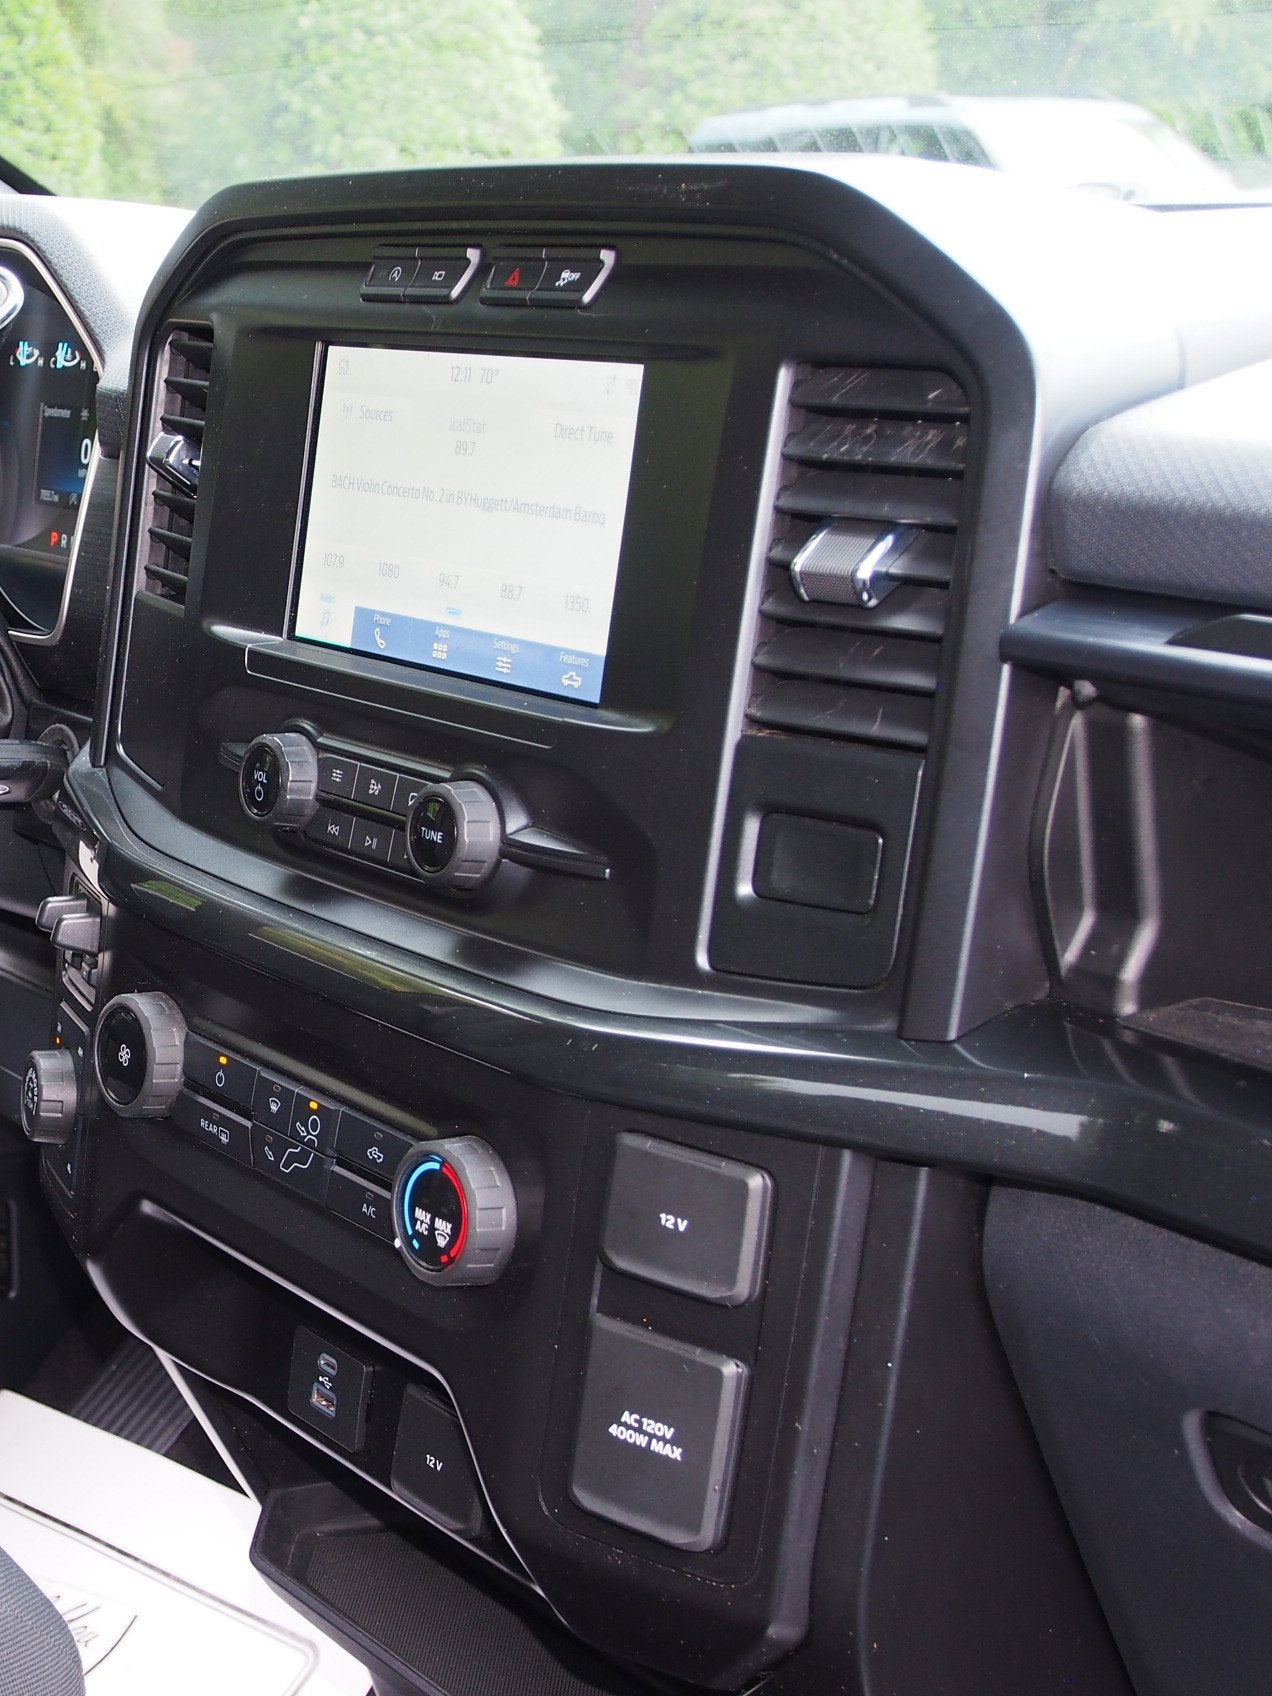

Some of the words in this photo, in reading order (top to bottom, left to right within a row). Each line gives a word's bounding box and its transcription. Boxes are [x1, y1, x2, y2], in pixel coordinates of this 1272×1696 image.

[450, 366, 472, 383] 12:11
[359, 404, 394, 423] Sources
[554, 423, 584, 441] Direct
[586, 425, 615, 444] Tune
[80, 438, 92, 465] 0
[454, 440, 477, 457] 89.7
[331, 473, 355, 491] BACH
[356, 477, 380, 494] Violin
[381, 480, 421, 500] Concerto
[438, 487, 445, 503] 2
[50, 531, 60, 547] P
[60, 534, 67, 549] R
[323, 552, 345, 569] 107.9
[378, 562, 400, 580] 1080
[438, 572, 460, 591] 94.7
[500, 583, 524, 602] 88.7
[564, 594, 590, 614] 1350
[373, 613, 393, 627] Phone
[434, 625, 451, 640] Apps
[492, 637, 520, 655] Settings
[559, 651, 590, 668] Features
[253, 769, 268, 784] VOL
[421, 826, 444, 844] TUNE
[200, 1118, 219, 1136] REAR
[361, 1203, 377, 1219] A/C
[414, 1206, 432, 1225] MAX
[415, 1220, 430, 1236] A/C
[434, 1217, 453, 1236] MAX
[620, 1410, 640, 1428] AC
[641, 1417, 675, 1440] 120V
[608, 1423, 649, 1448] 400W
[650, 1438, 683, 1461] MAX
